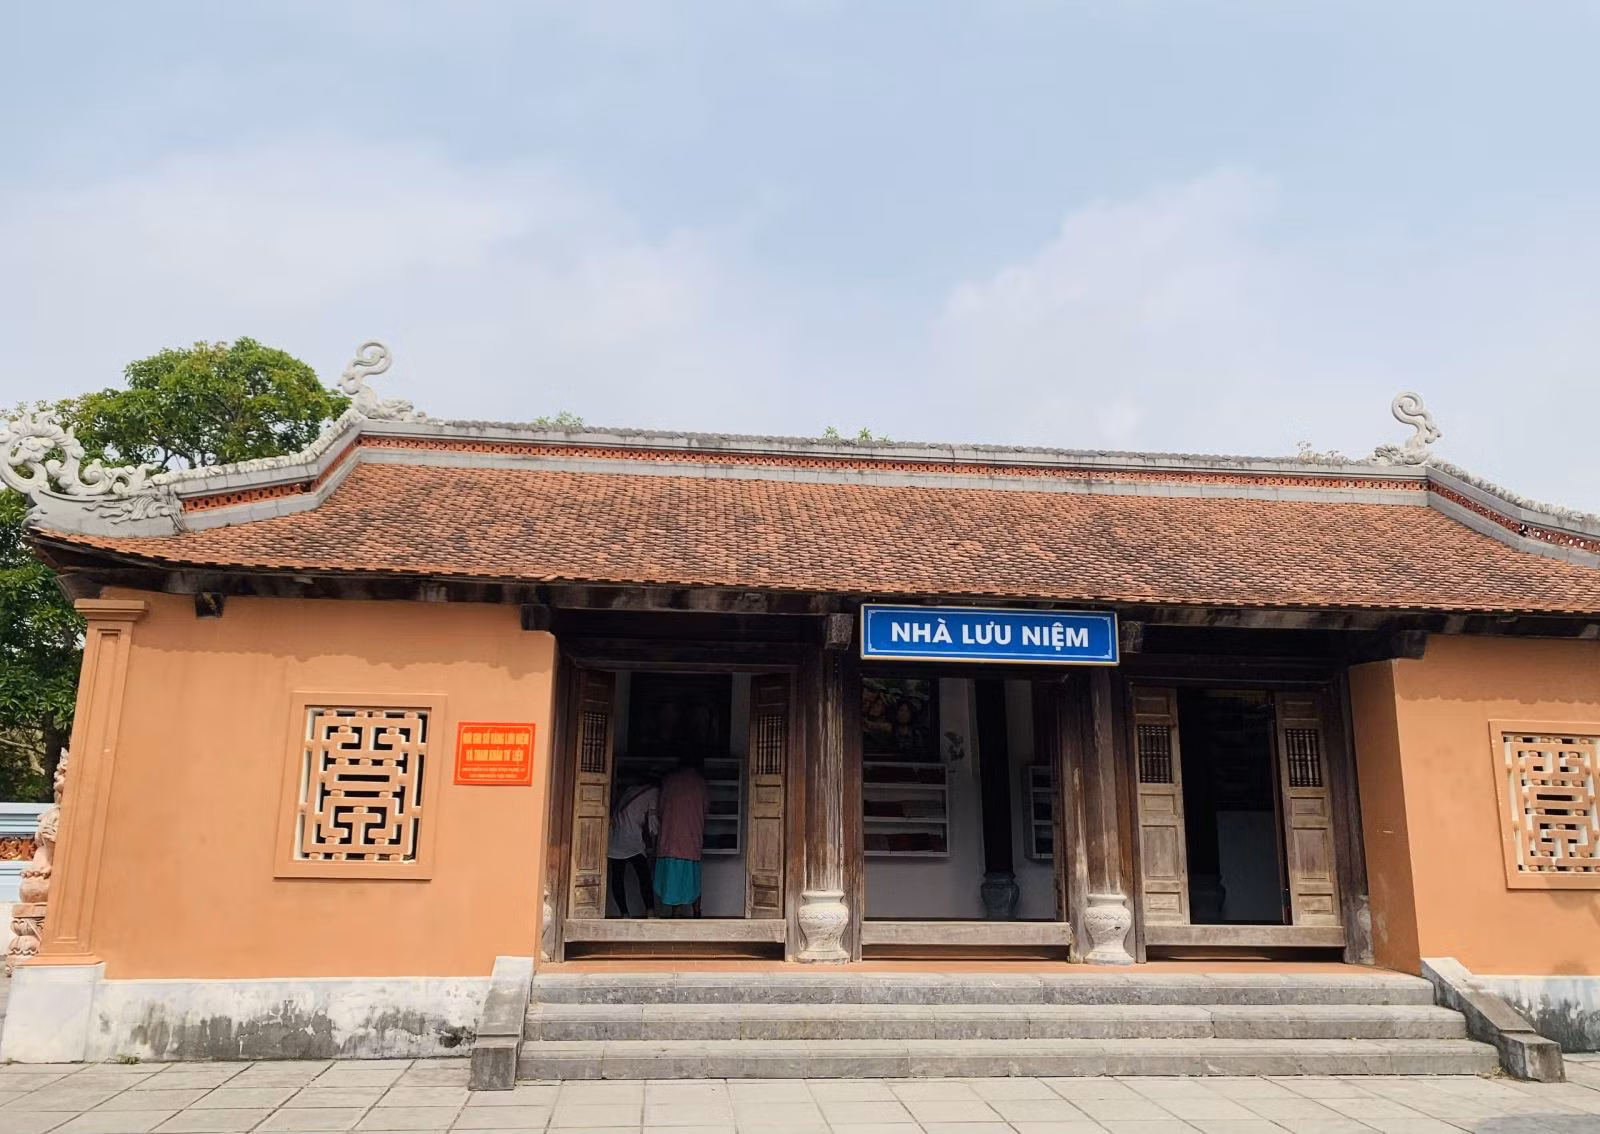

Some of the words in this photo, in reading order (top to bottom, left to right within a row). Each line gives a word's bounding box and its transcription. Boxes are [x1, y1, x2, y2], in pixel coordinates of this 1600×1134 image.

[892, 618, 952, 643] NHÀ
[962, 621, 1011, 644] LƯU
[1022, 622, 1088, 651] NIỆM
